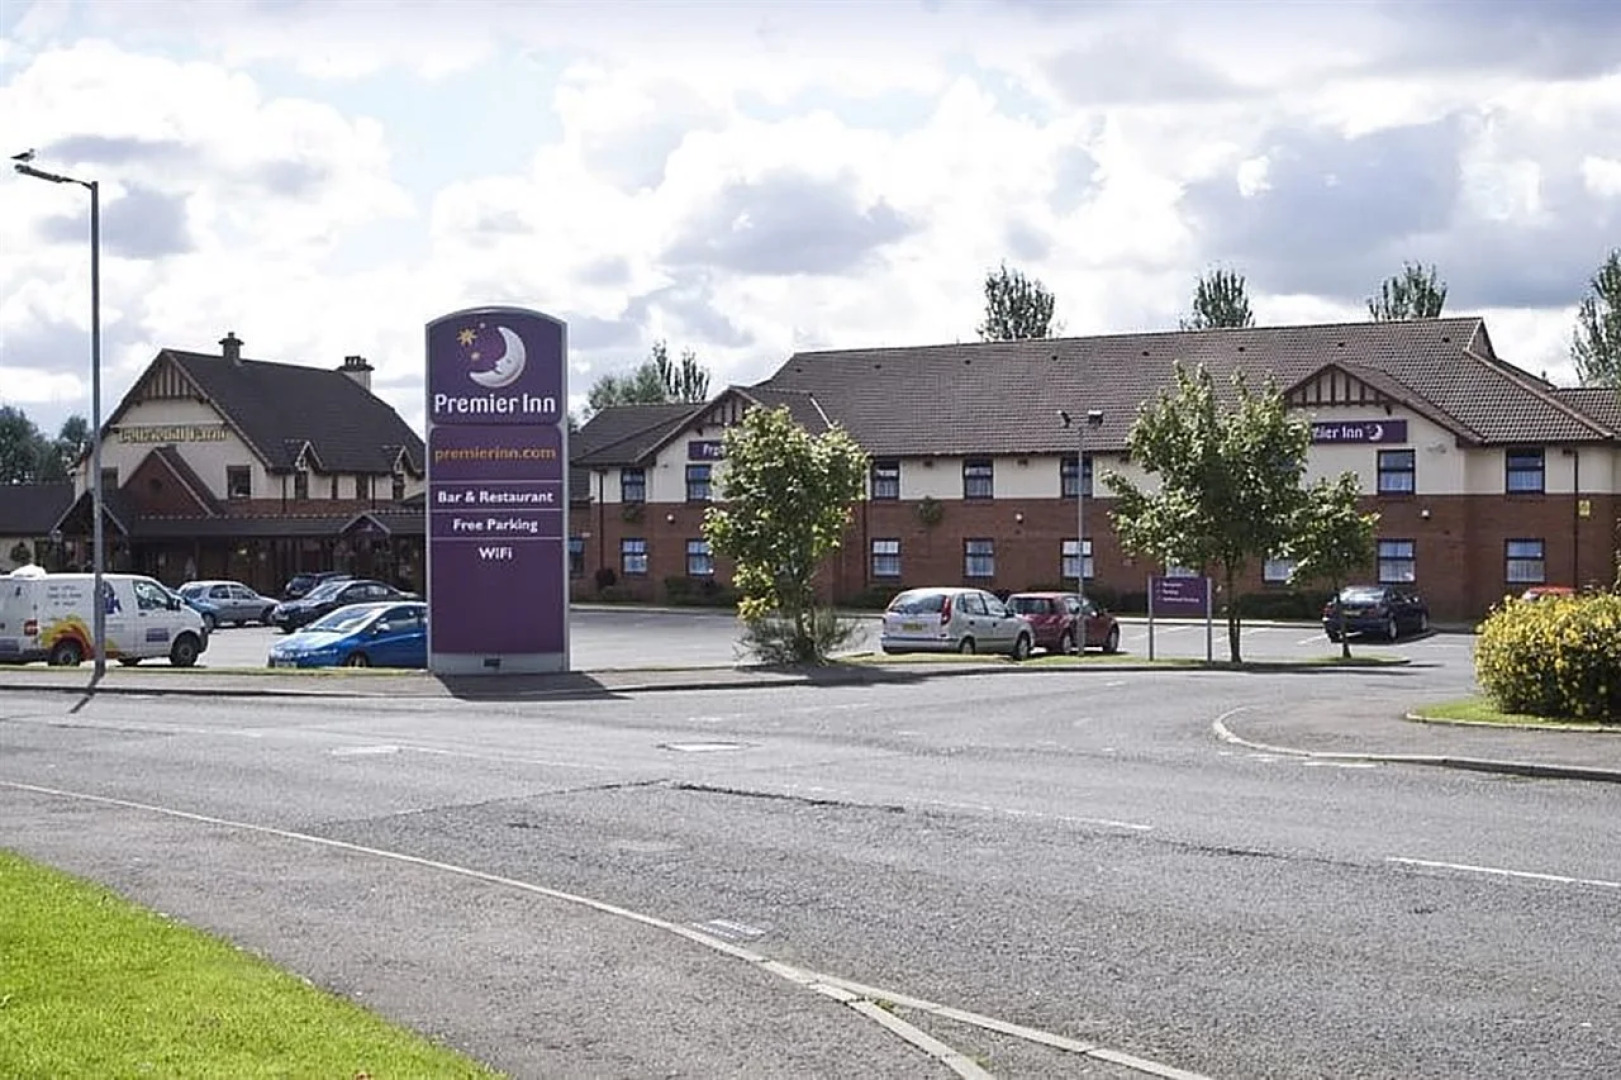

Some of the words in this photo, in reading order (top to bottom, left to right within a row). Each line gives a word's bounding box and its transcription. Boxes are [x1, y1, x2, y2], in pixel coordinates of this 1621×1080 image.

[434, 393, 519, 413] Premier
[523, 393, 556, 413] Inn
[1342, 425, 1363, 439] Inn
[434, 446, 557, 462] premierinn.com
[437, 490, 462, 503] Bar
[465, 490, 475, 503] &
[479, 490, 554, 503] Restaurant
[453, 518, 483, 531] Free
[487, 518, 538, 533] Parking
[479, 546, 513, 560] WiFi
